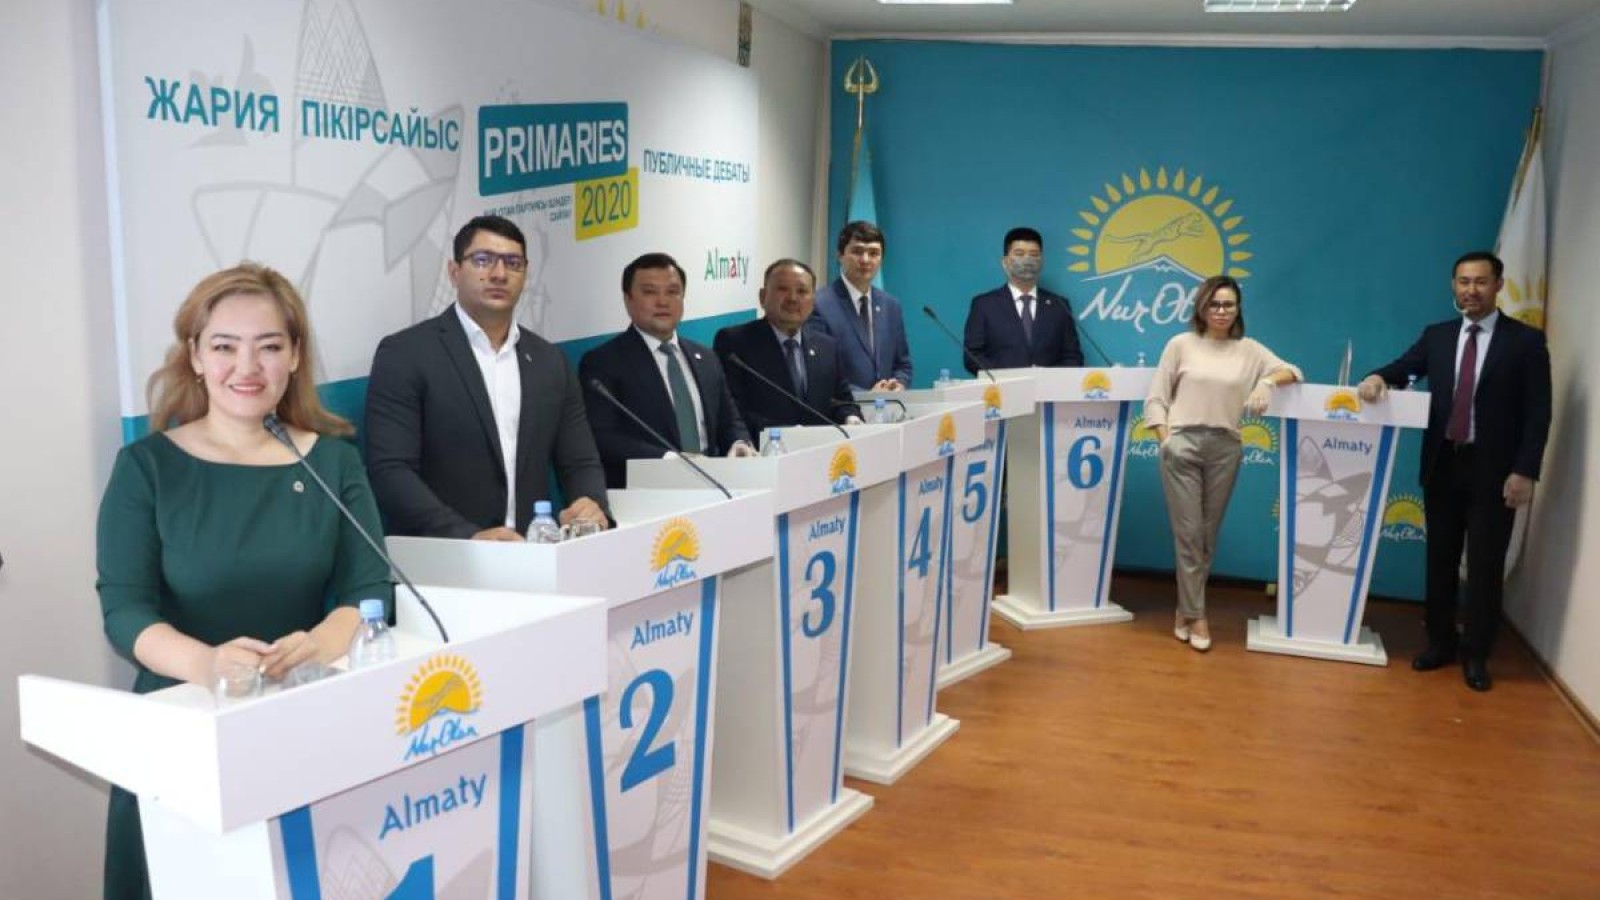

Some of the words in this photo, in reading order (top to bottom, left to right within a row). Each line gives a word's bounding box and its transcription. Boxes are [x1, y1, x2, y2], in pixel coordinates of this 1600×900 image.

[144, 76, 279, 133] ЖАРИЯ
[301, 99, 459, 151] ПІКІРСАЙЫС
[484, 119, 626, 178] PRIMARIES
[643, 149, 711, 179] ПУБЛИЧНЫЕ
[713, 160, 750, 183] ДЕБАТЫ
[581, 180, 631, 227] 2020
[704, 247, 748, 285] Almaty
[1079, 274, 1150, 333] Nur
[1152, 282, 1197, 324] Ot
[1074, 416, 1113, 431] Almaty
[1323, 436, 1373, 455] Almaty
[1067, 435, 1104, 490] 6
[962, 460, 987, 523] 5
[808, 513, 846, 542] Almaty
[908, 506, 932, 578] 4
[802, 550, 836, 638] 3
[630, 611, 693, 649] Almaty
[619, 668, 676, 793] 2
[379, 773, 487, 840] Almaty
